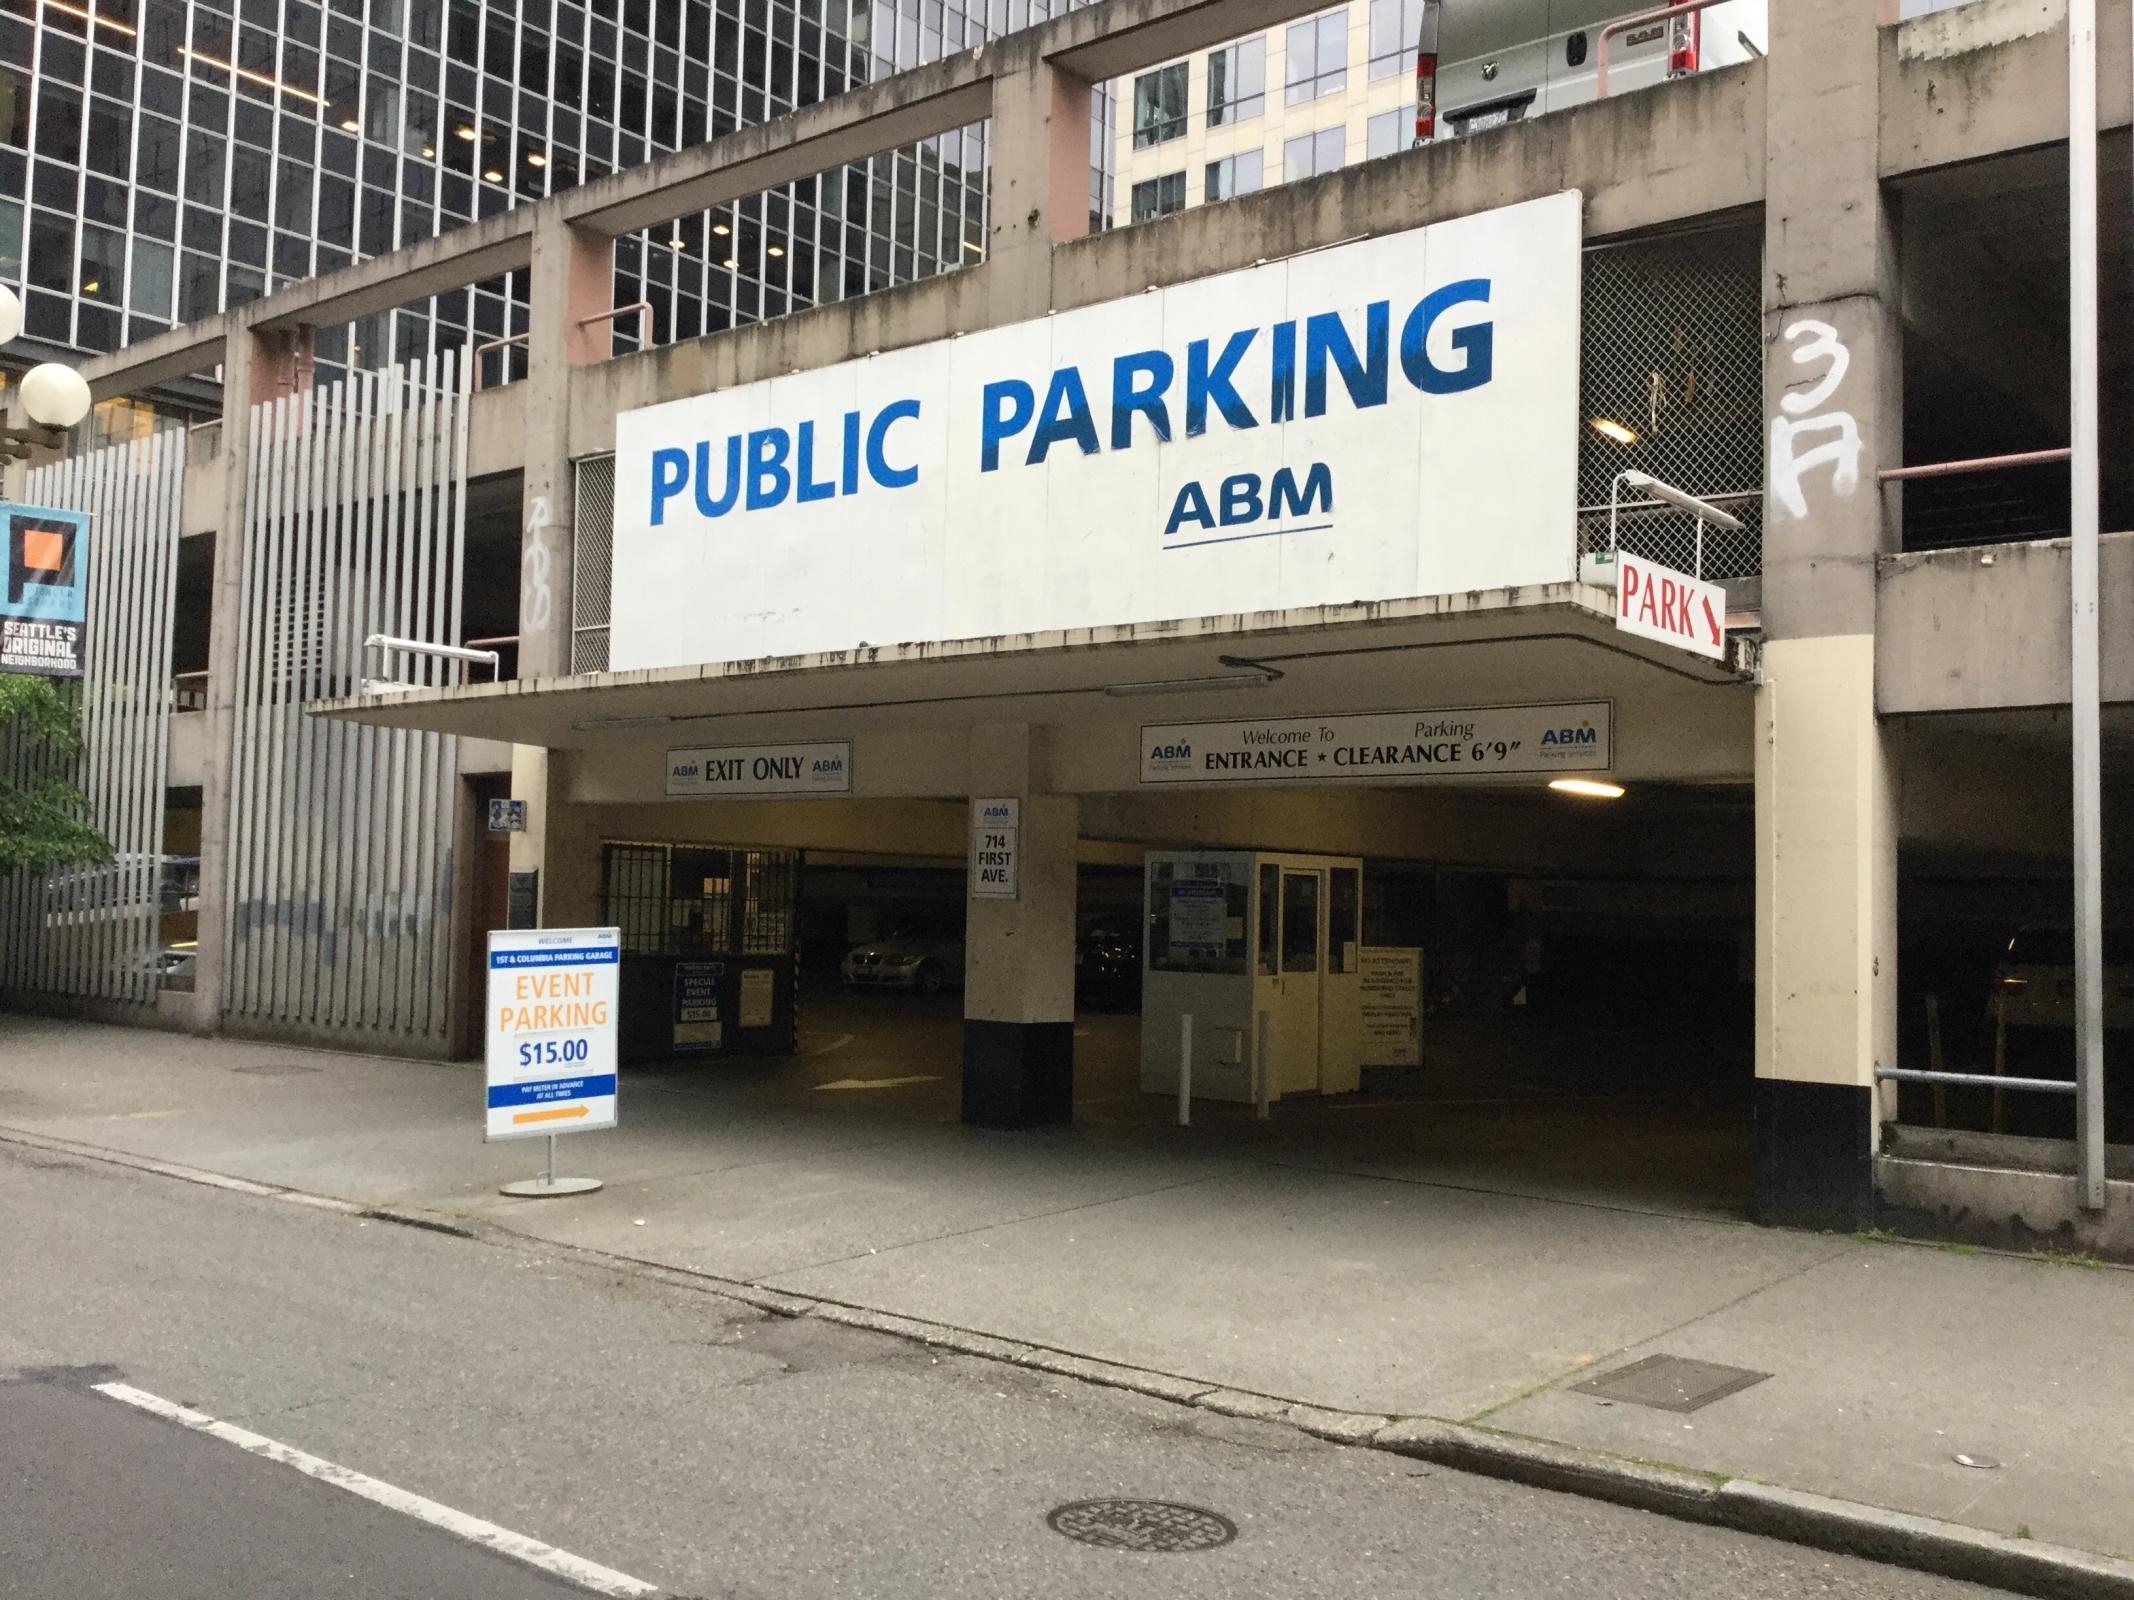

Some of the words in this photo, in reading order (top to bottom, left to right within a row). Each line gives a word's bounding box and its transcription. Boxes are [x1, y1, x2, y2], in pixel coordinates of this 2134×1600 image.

[650, 399, 921, 526] PUBLIC
[980, 277, 1493, 473] PARKING
[1164, 462, 1333, 535] ABM
[1622, 563, 1695, 639] PARK
[3, 620, 77, 642] SEATTLE'S
[3, 637, 77, 659] ORIGINAL
[1, 653, 77, 670] NEIGHBORHOOD
[1242, 727, 1311, 746] Welcome
[1318, 726, 1335, 743] To
[1414, 720, 1476, 741] Parking
[1540, 727, 1597, 745] ABM
[1150, 744, 1192, 759] ABM
[1204, 749, 1309, 771] ENTRANCE
[1333, 743, 1462, 767] CLEARANCE
[672, 765, 698, 777] ABM
[705, 758, 745, 782] EXIT
[752, 756, 804, 781] ONLY
[812, 760, 842, 772] ABM
[983, 807, 1009, 817] ABM
[985, 834, 1006, 849] 714
[978, 851, 1012, 866] FIRST
[980, 868, 1009, 883] AVE.
[538, 936, 573, 945] WELCOME
[496, 955, 508, 964] 1ST
[509, 955, 516, 964] &
[517, 953, 554, 963] COLUMBIA
[554, 952, 585, 962] PARKING
[585, 951, 613, 960] GARAGE
[516, 972, 595, 1000] EVENT
[684, 977, 715, 987] SPECIAL
[686, 988, 711, 997] EVENT
[682, 998, 717, 1008] PARKING
[500, 1001, 607, 1032] PARKING
[519, 1038, 588, 1067] $15.00
[559, 1081, 584, 1089] ADVANCE
